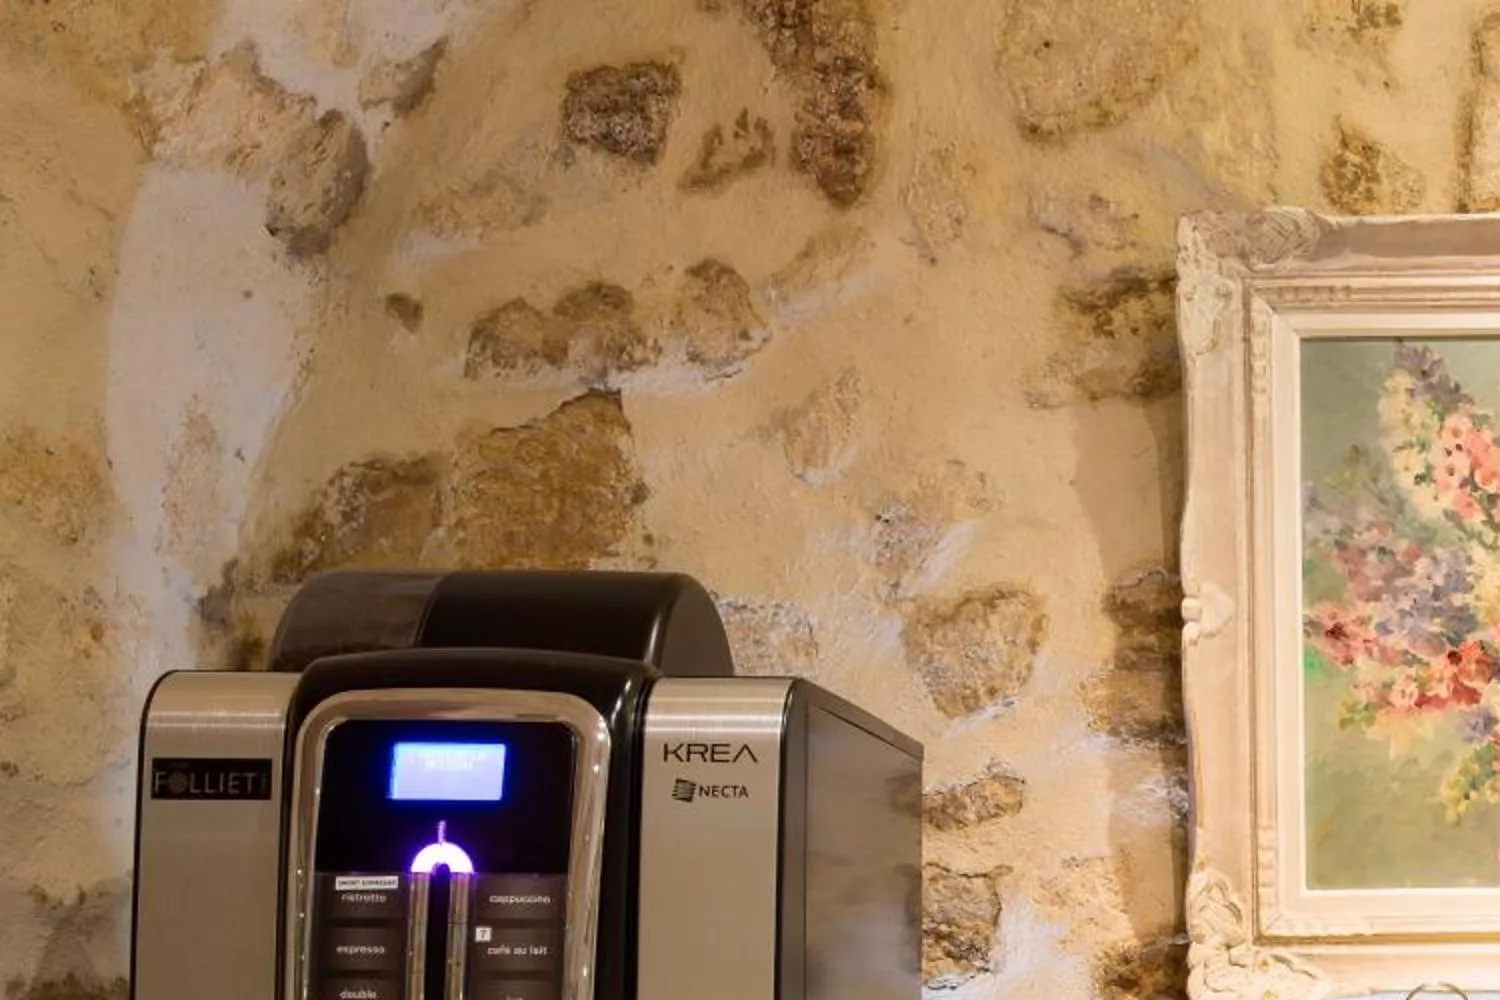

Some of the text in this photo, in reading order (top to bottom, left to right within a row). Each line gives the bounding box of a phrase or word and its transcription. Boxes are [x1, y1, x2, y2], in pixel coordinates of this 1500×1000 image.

[663, 743, 758, 763] KREA
[699, 784, 749, 798] NECTA
[336, 946, 386, 956] espresso
[513, 947, 527, 955] au
[529, 945, 547, 955] lait
[340, 988, 377, 999] double
